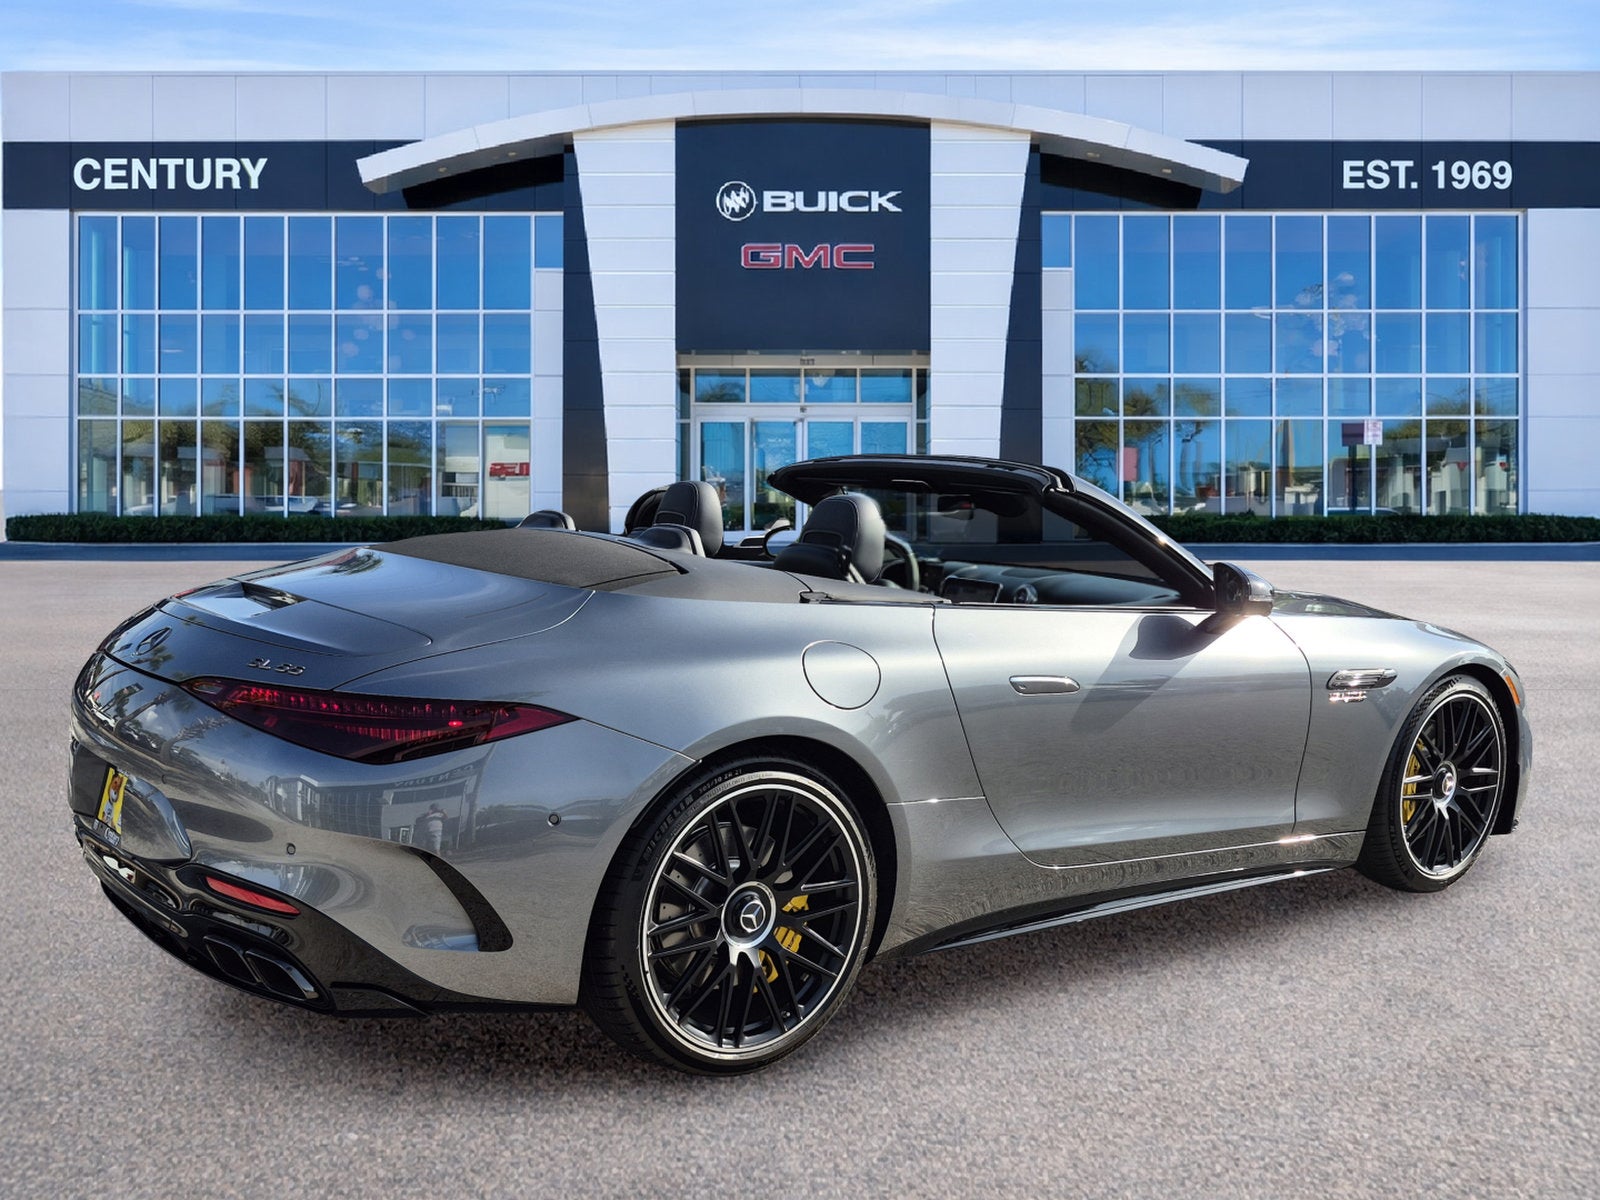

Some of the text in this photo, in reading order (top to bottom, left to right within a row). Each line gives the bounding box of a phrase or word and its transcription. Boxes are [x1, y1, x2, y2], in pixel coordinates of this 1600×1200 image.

[73, 157, 268, 191] CENTURY
[1342, 159, 1513, 191] EST. 1969
[763, 190, 903, 213] BUICK
[740, 243, 875, 269] GMC
[248, 658, 271, 670] SL
[642, 794, 695, 863] MICHELIN
